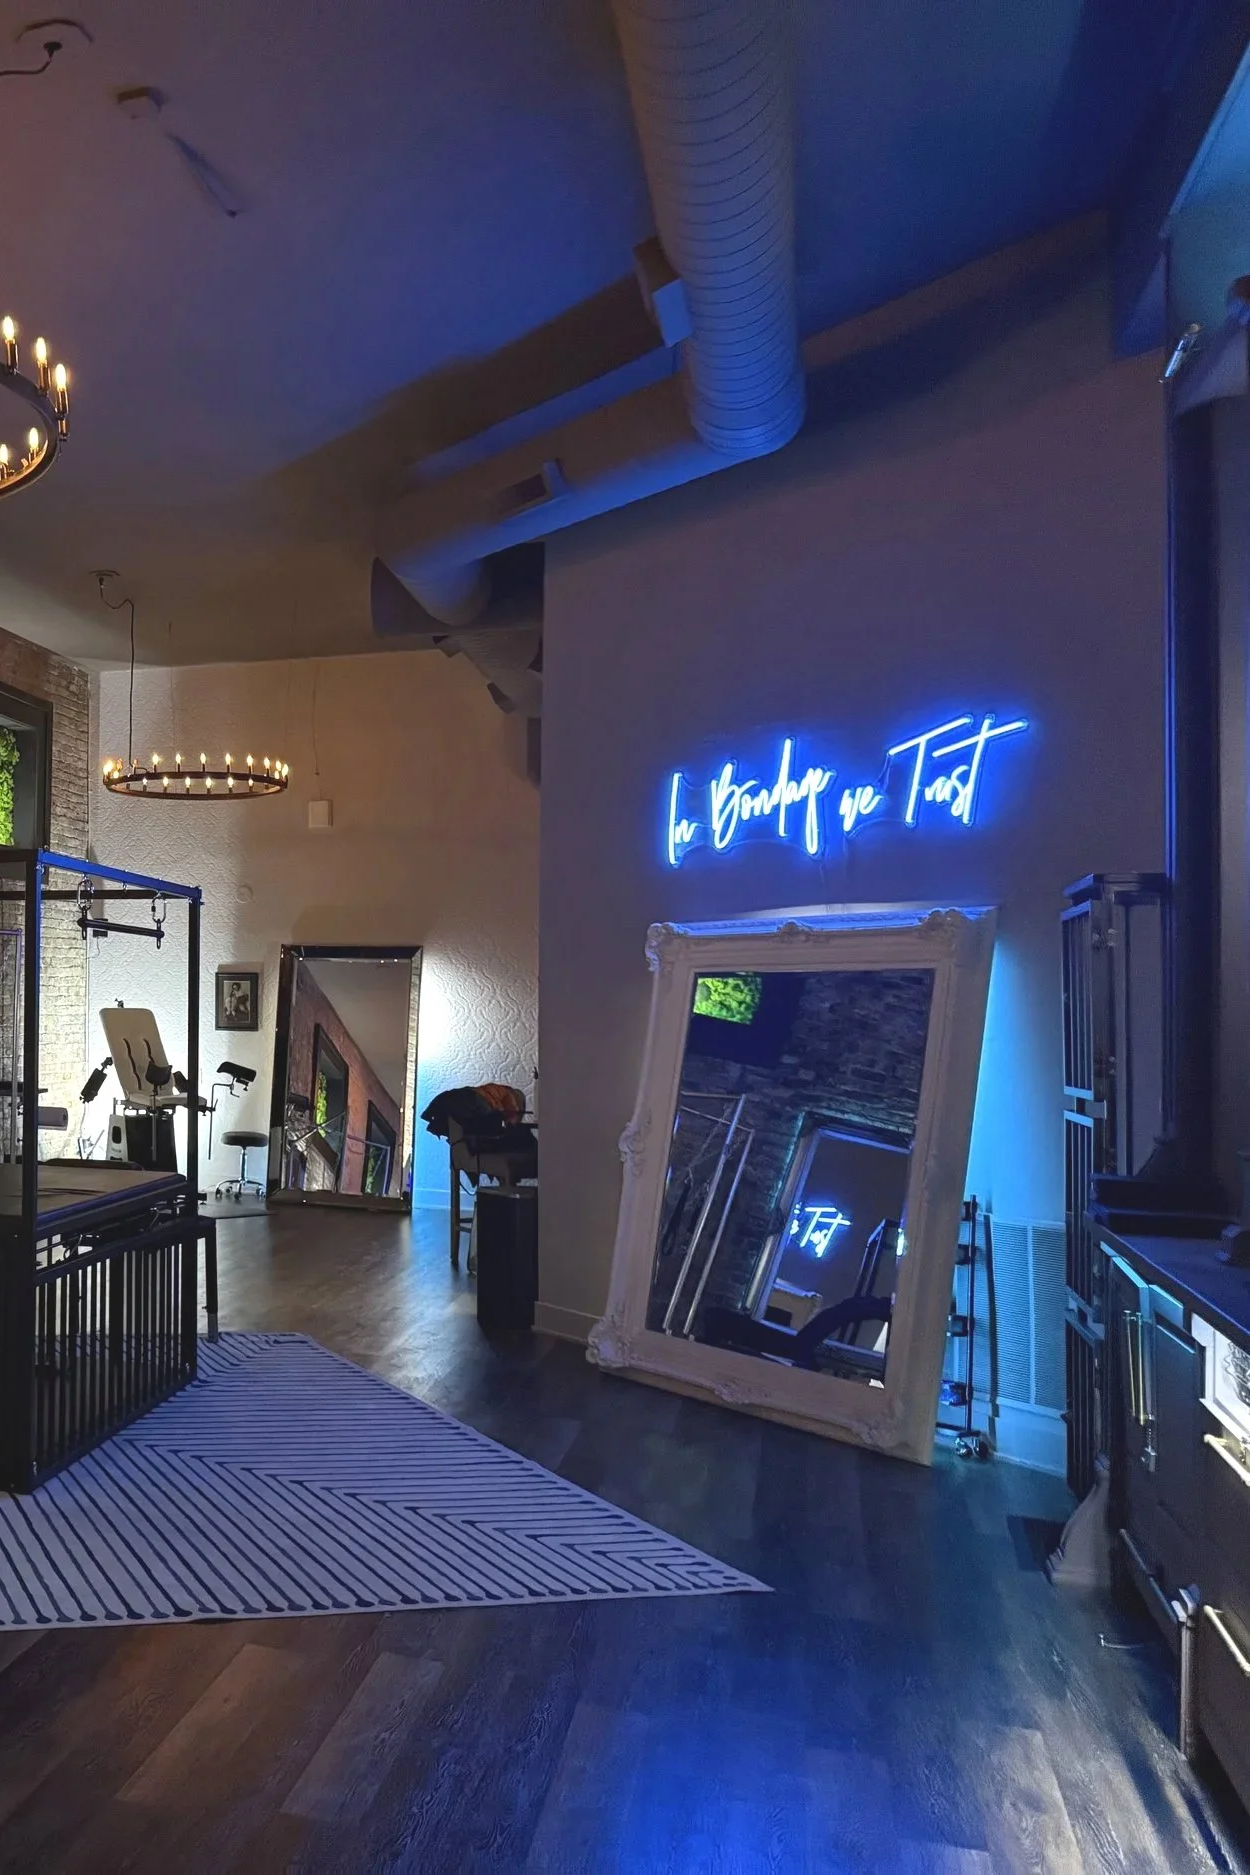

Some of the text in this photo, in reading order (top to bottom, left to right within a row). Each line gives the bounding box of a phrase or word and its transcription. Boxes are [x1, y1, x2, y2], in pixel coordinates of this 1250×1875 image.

[668, 772, 698, 866] In
[710, 736, 836, 854] Bondage
[887, 713, 1029, 825] Trust
